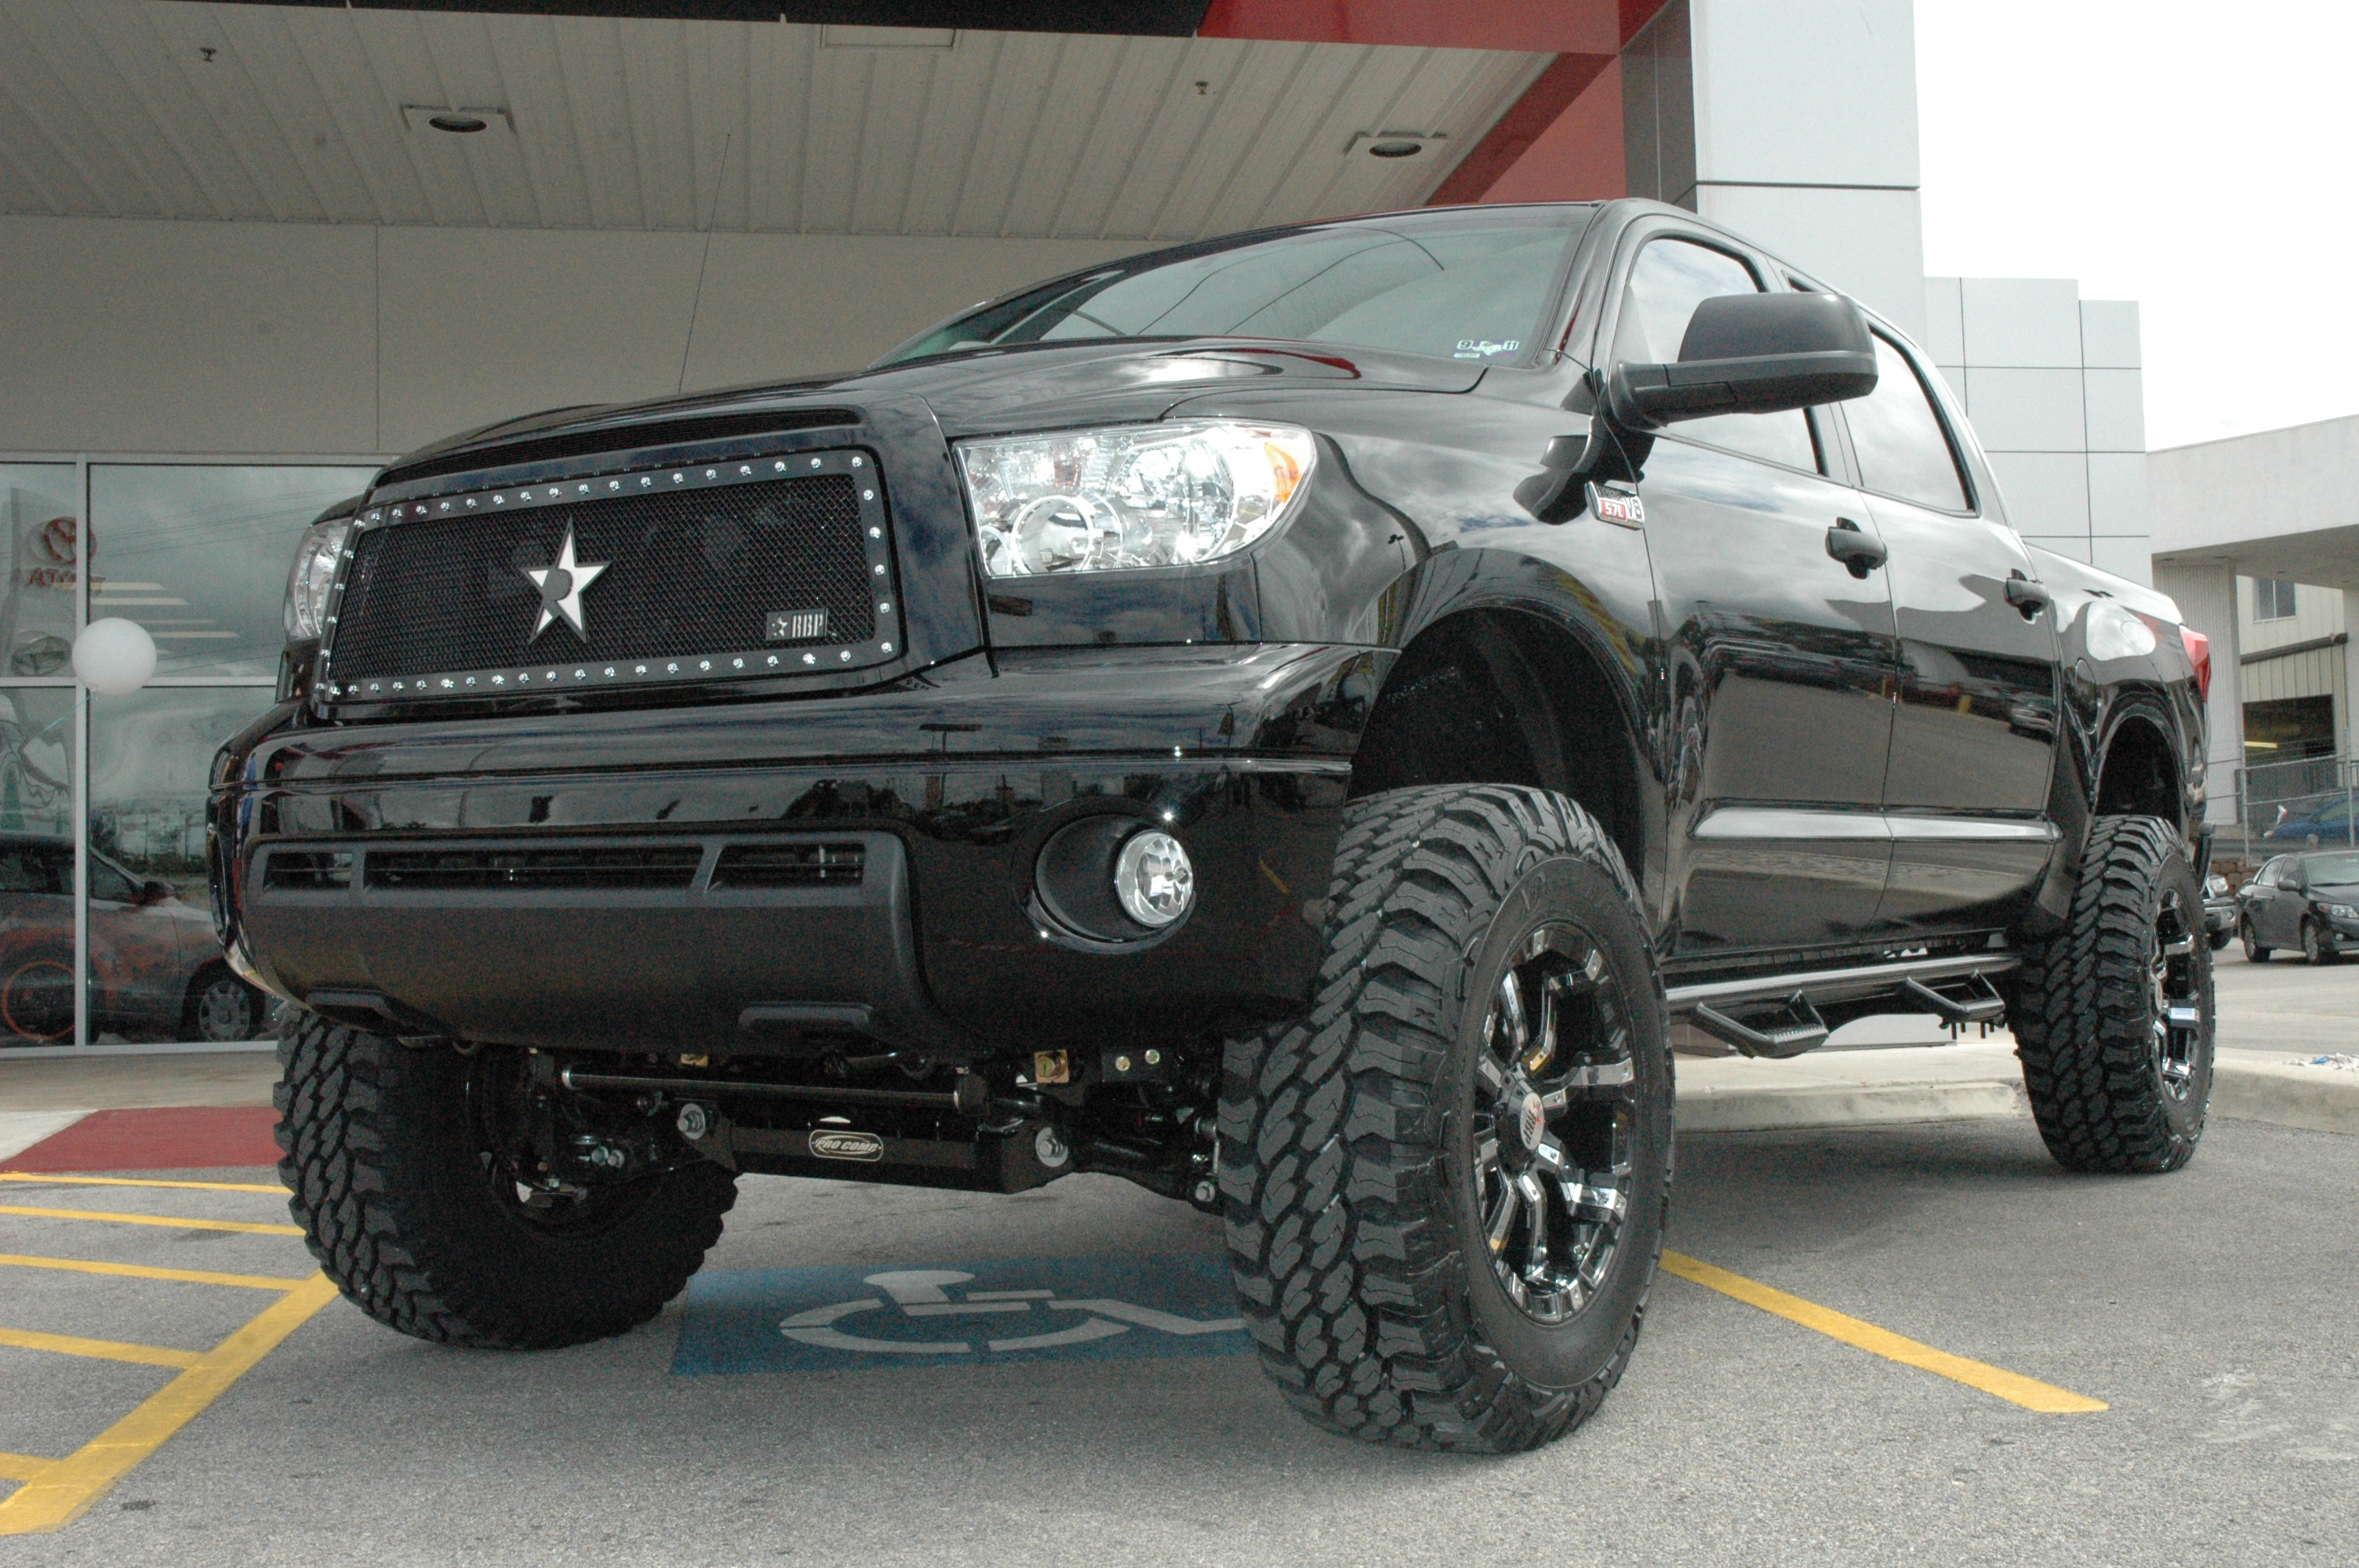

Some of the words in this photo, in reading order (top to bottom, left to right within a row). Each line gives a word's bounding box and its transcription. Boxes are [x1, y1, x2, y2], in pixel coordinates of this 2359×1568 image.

[1504, 340, 1518, 350] 11
[791, 613, 823, 638] RBP
[1522, 1108, 1537, 1145] RBP
[815, 1138, 842, 1150] PRO
[841, 1141, 879, 1152] COMP
